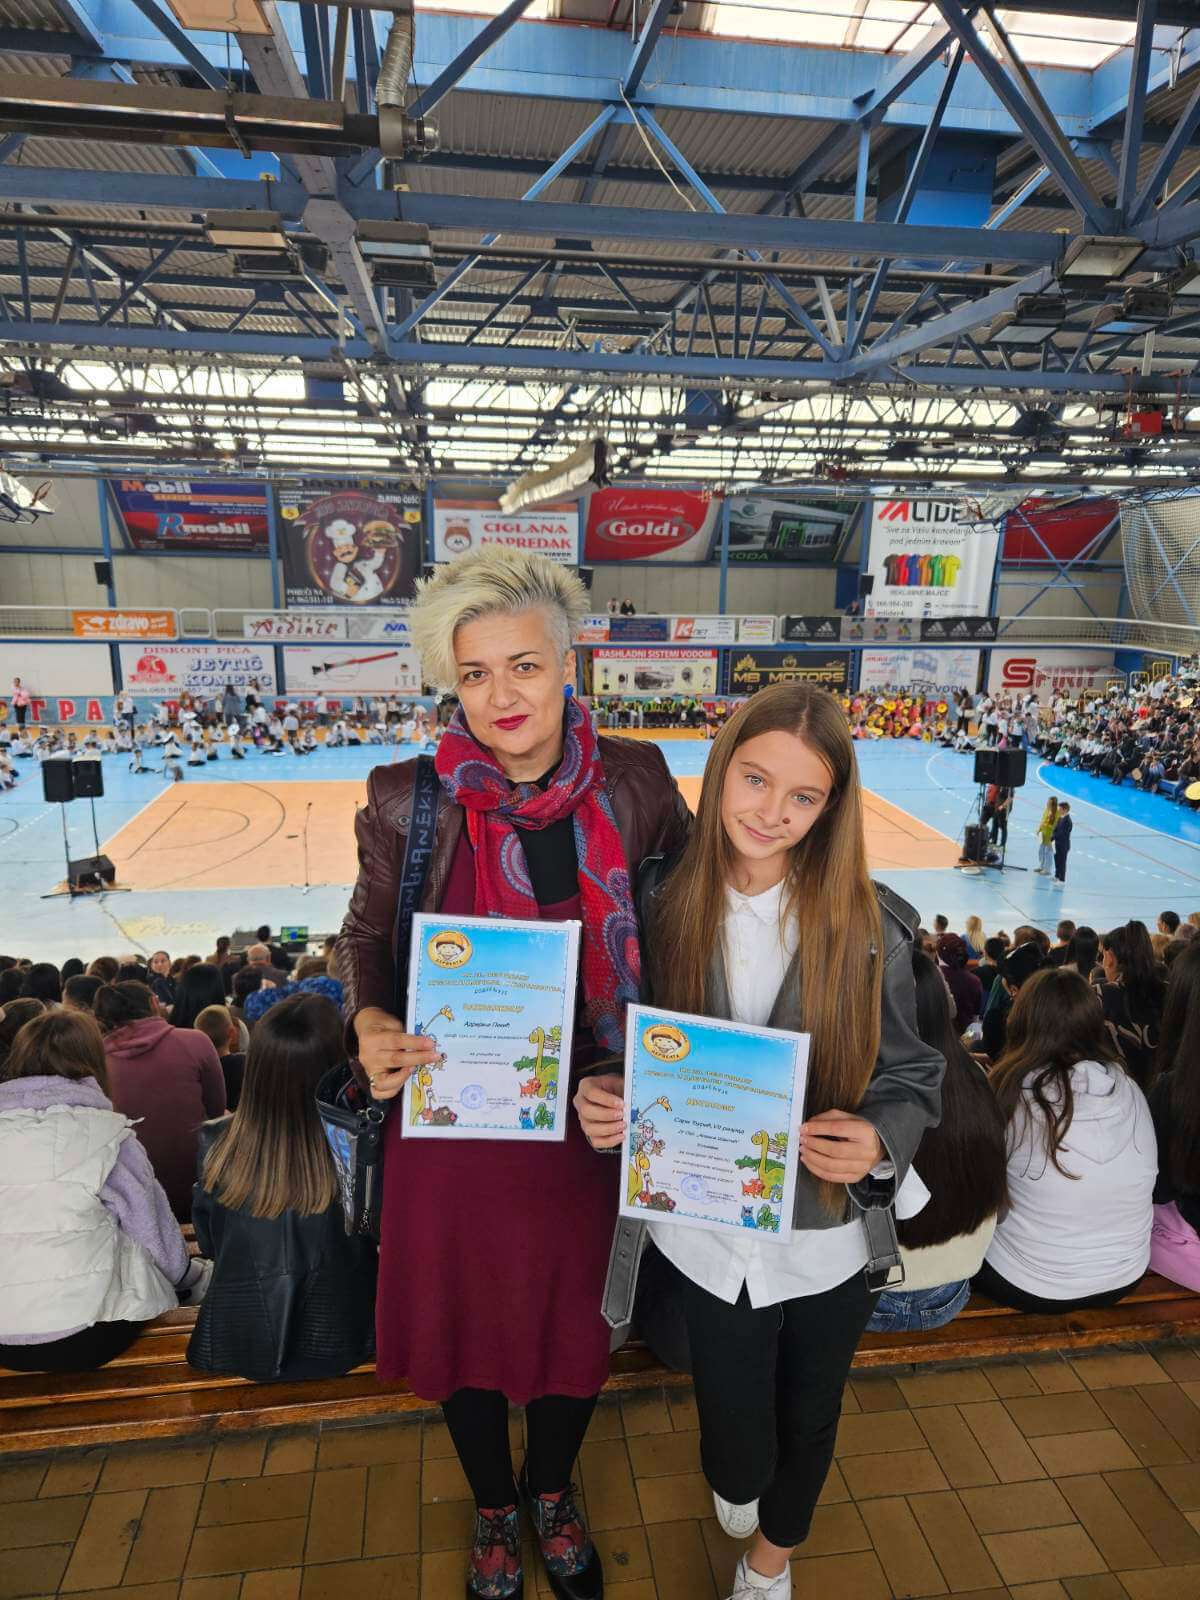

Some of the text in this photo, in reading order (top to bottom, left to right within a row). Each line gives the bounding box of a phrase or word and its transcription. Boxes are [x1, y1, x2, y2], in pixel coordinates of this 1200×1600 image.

[483, 522, 568, 534] CIGLANA
[609, 518, 683, 537] Goldi
[143, 647, 210, 655] DISKONT
[599, 648, 646, 658] RASHLADNI
[647, 648, 680, 658] SISTEMI
[190, 655, 263, 672] JEVTIĆ
[733, 672, 845, 683] MB MOTORS
